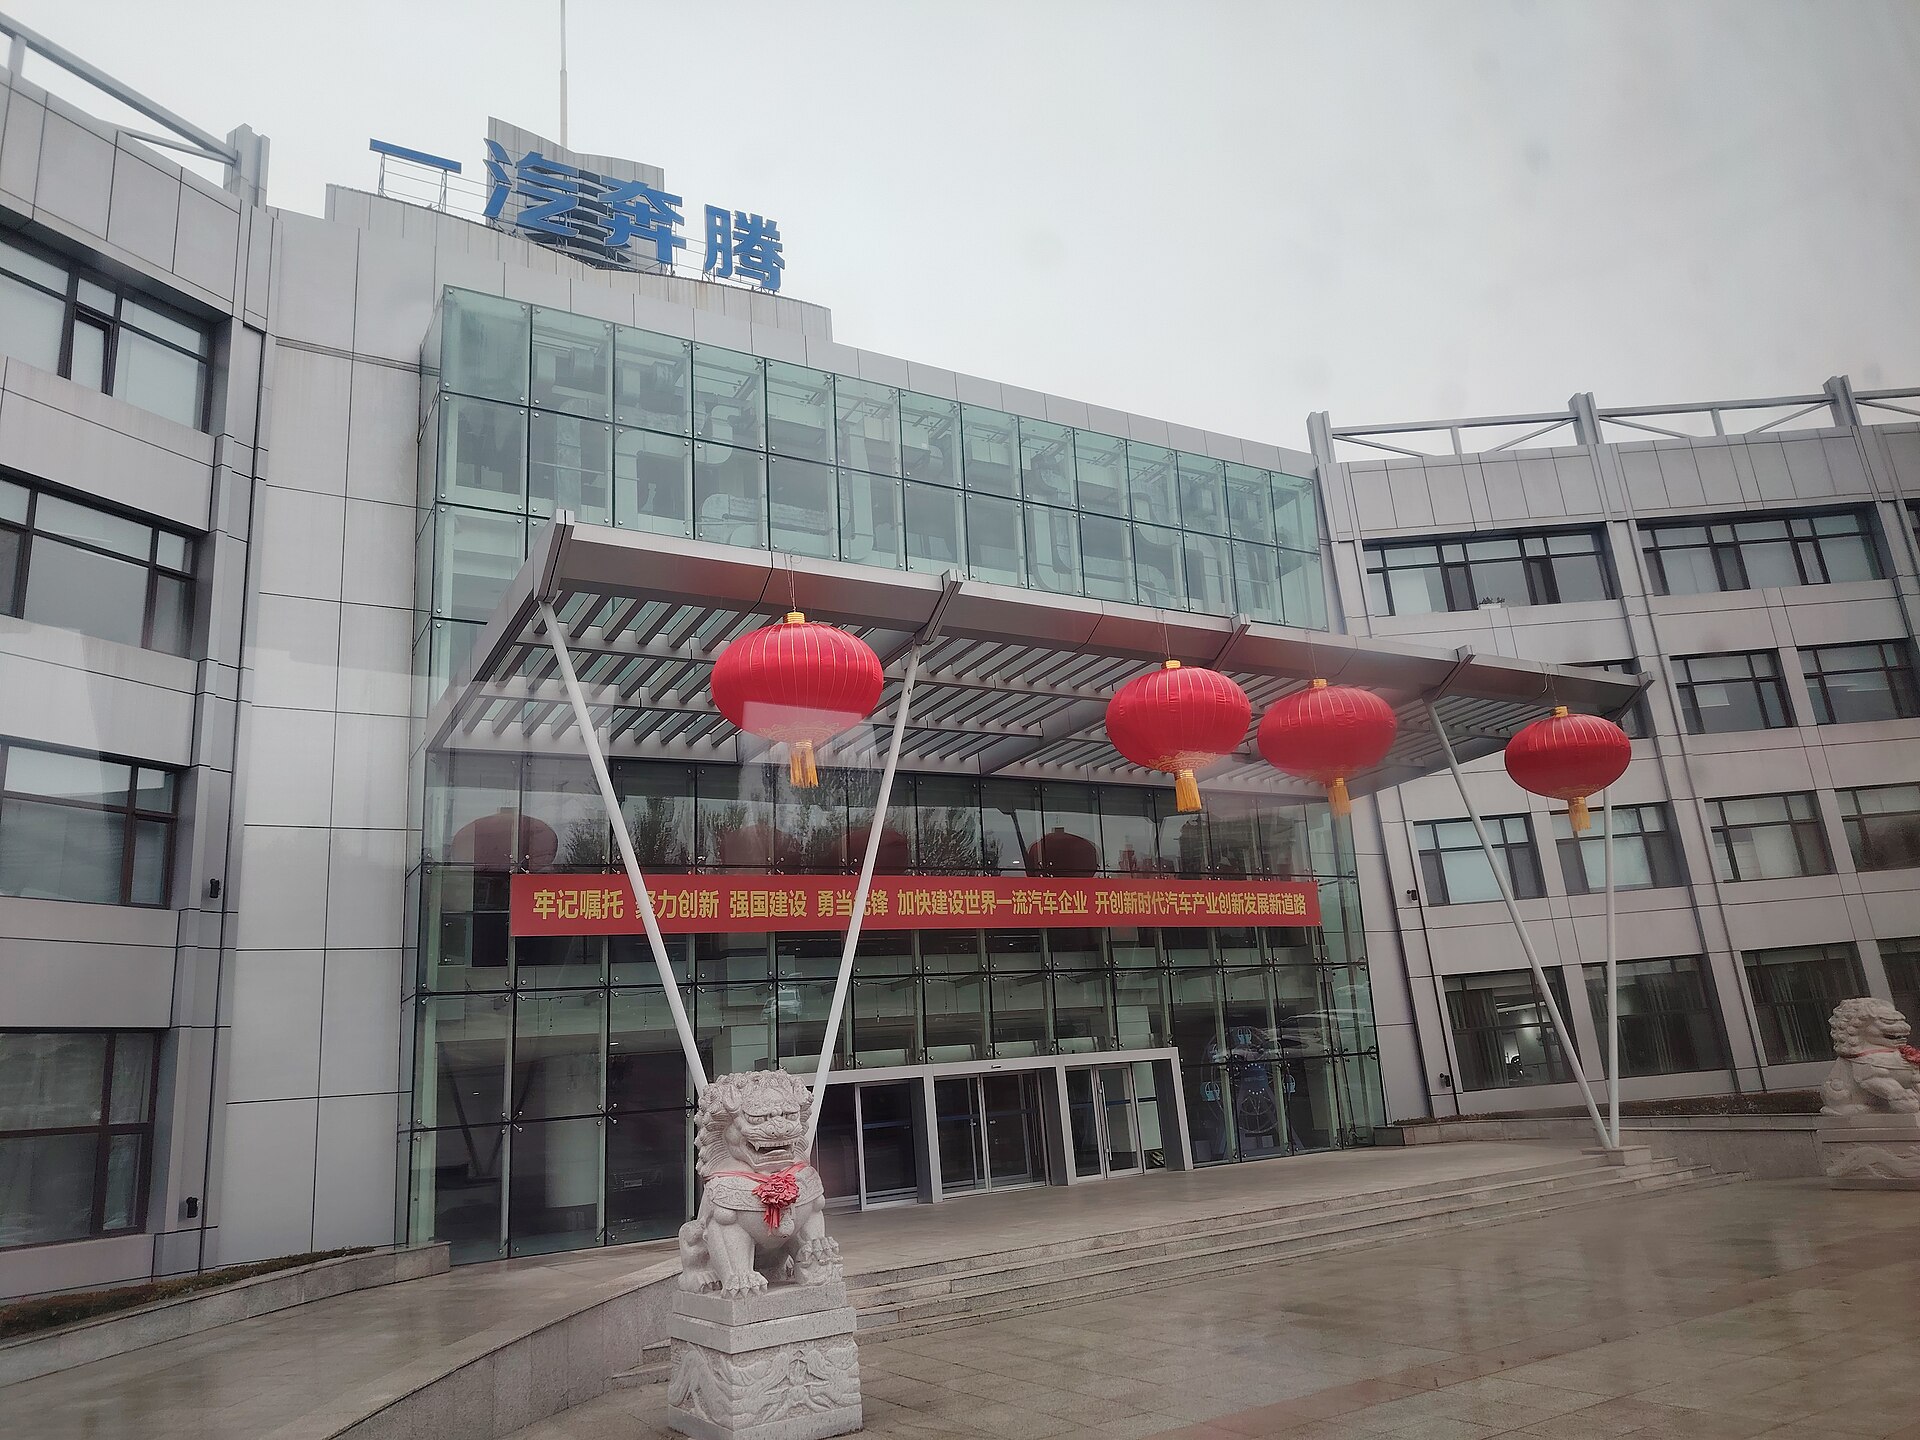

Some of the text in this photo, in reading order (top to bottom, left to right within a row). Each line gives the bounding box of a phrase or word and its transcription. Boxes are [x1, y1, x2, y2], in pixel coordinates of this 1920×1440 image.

[370, 137, 786, 291] 一汽奔腾
[532, 889, 624, 919] 牢记嘱托
[729, 889, 807, 918] 强国建设
[897, 888, 1088, 916] 加快建设世界一流汽车企业
[1095, 890, 1307, 916] 开创新时代汽车产业创新发展新道路
